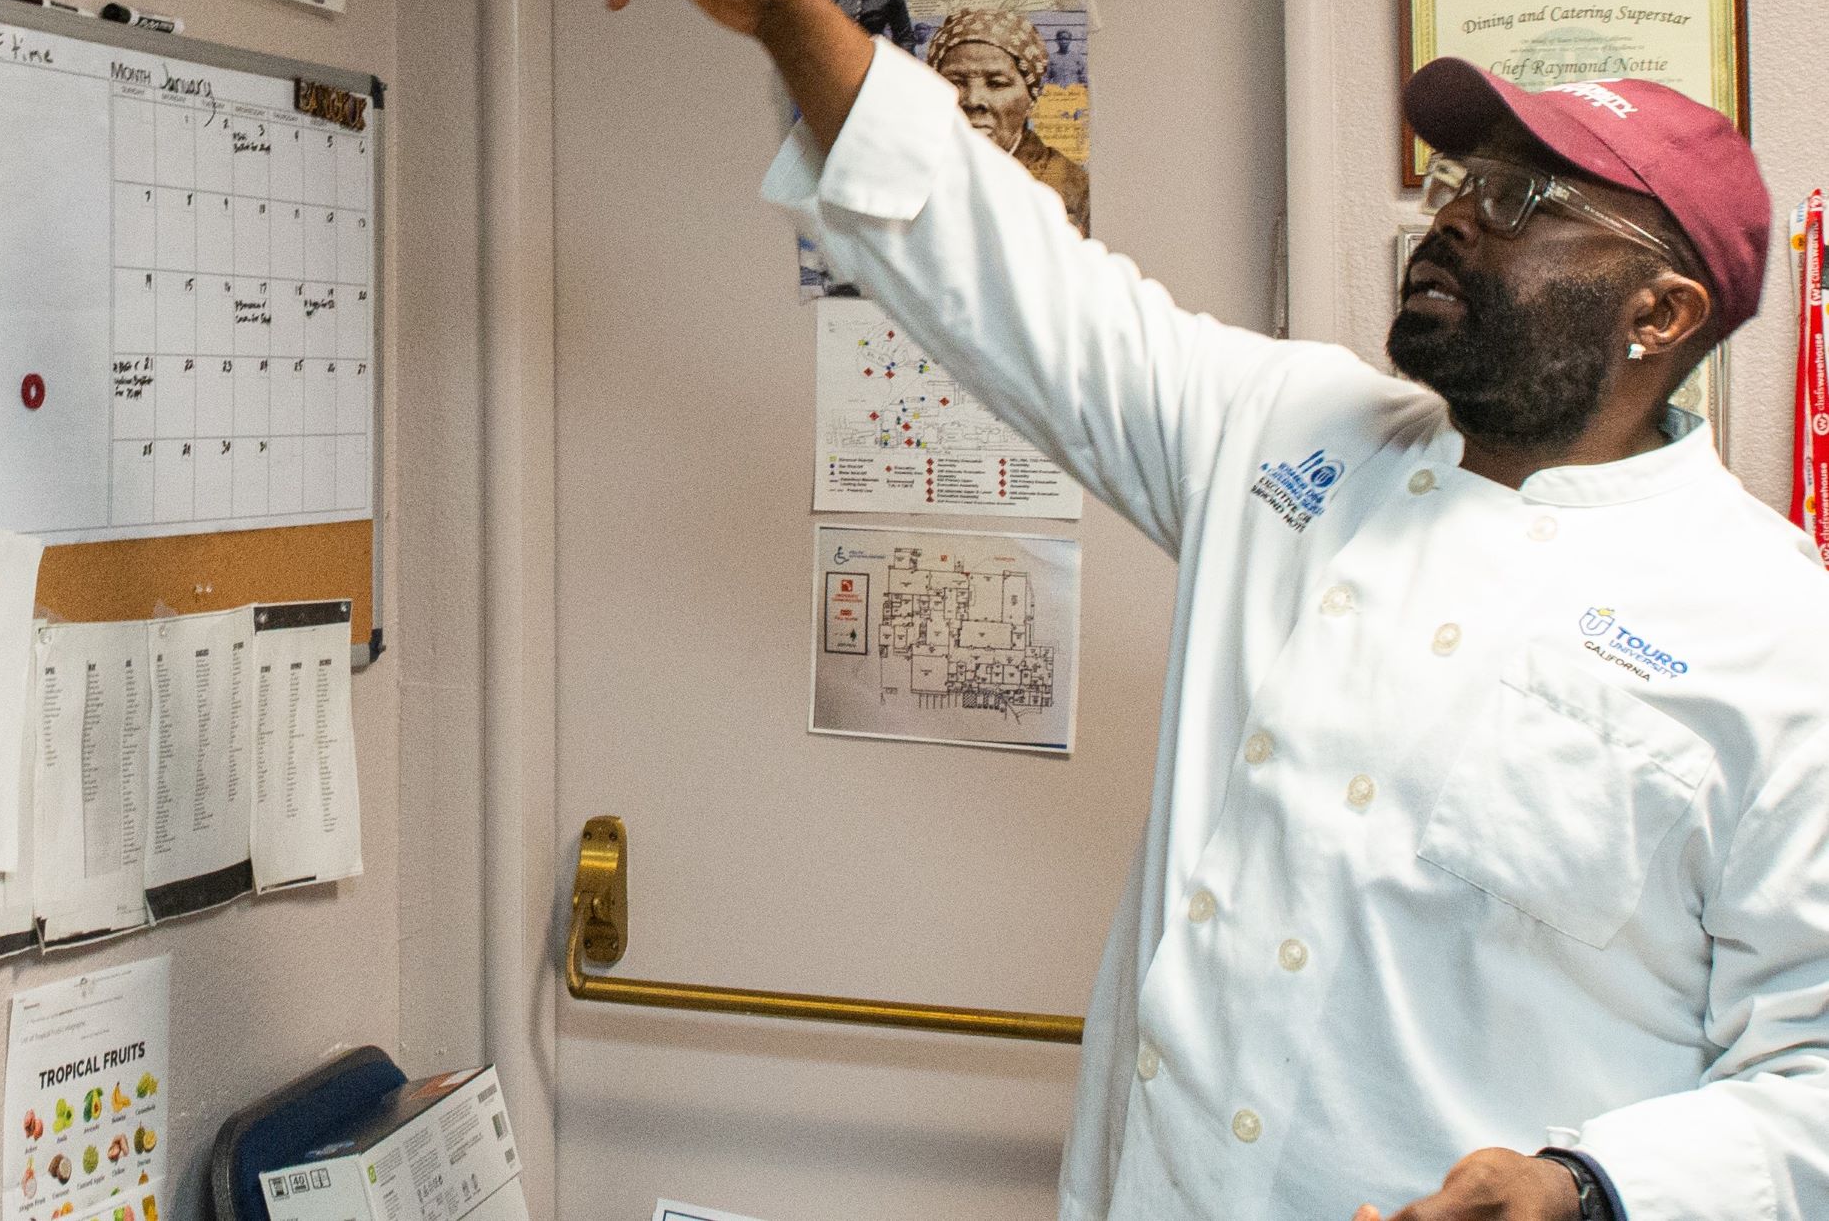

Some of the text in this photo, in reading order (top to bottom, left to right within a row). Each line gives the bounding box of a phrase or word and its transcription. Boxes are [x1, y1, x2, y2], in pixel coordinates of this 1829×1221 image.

[1462, 4, 1692, 35] Dining and Catering Superstar
[12, 36, 55, 64] time
[1490, 56, 1669, 81] Chef Raymond Nottie
[110, 61, 152, 86] MONTH
[158, 63, 217, 126] January
[222, 359, 233, 372] 23
[1815, 333, 1824, 413] chefswarehouse
[1259, 476, 1300, 514] EXECUTIVE
[1819, 462, 1829, 539] chefswarehouse
[1584, 640, 1651, 682] CALIFORNIA
[1608, 639, 1679, 680] UNIVERSITY
[1616, 626, 1689, 675] TOURO
[39, 1040, 146, 1091] TROPICAL FRUITS
